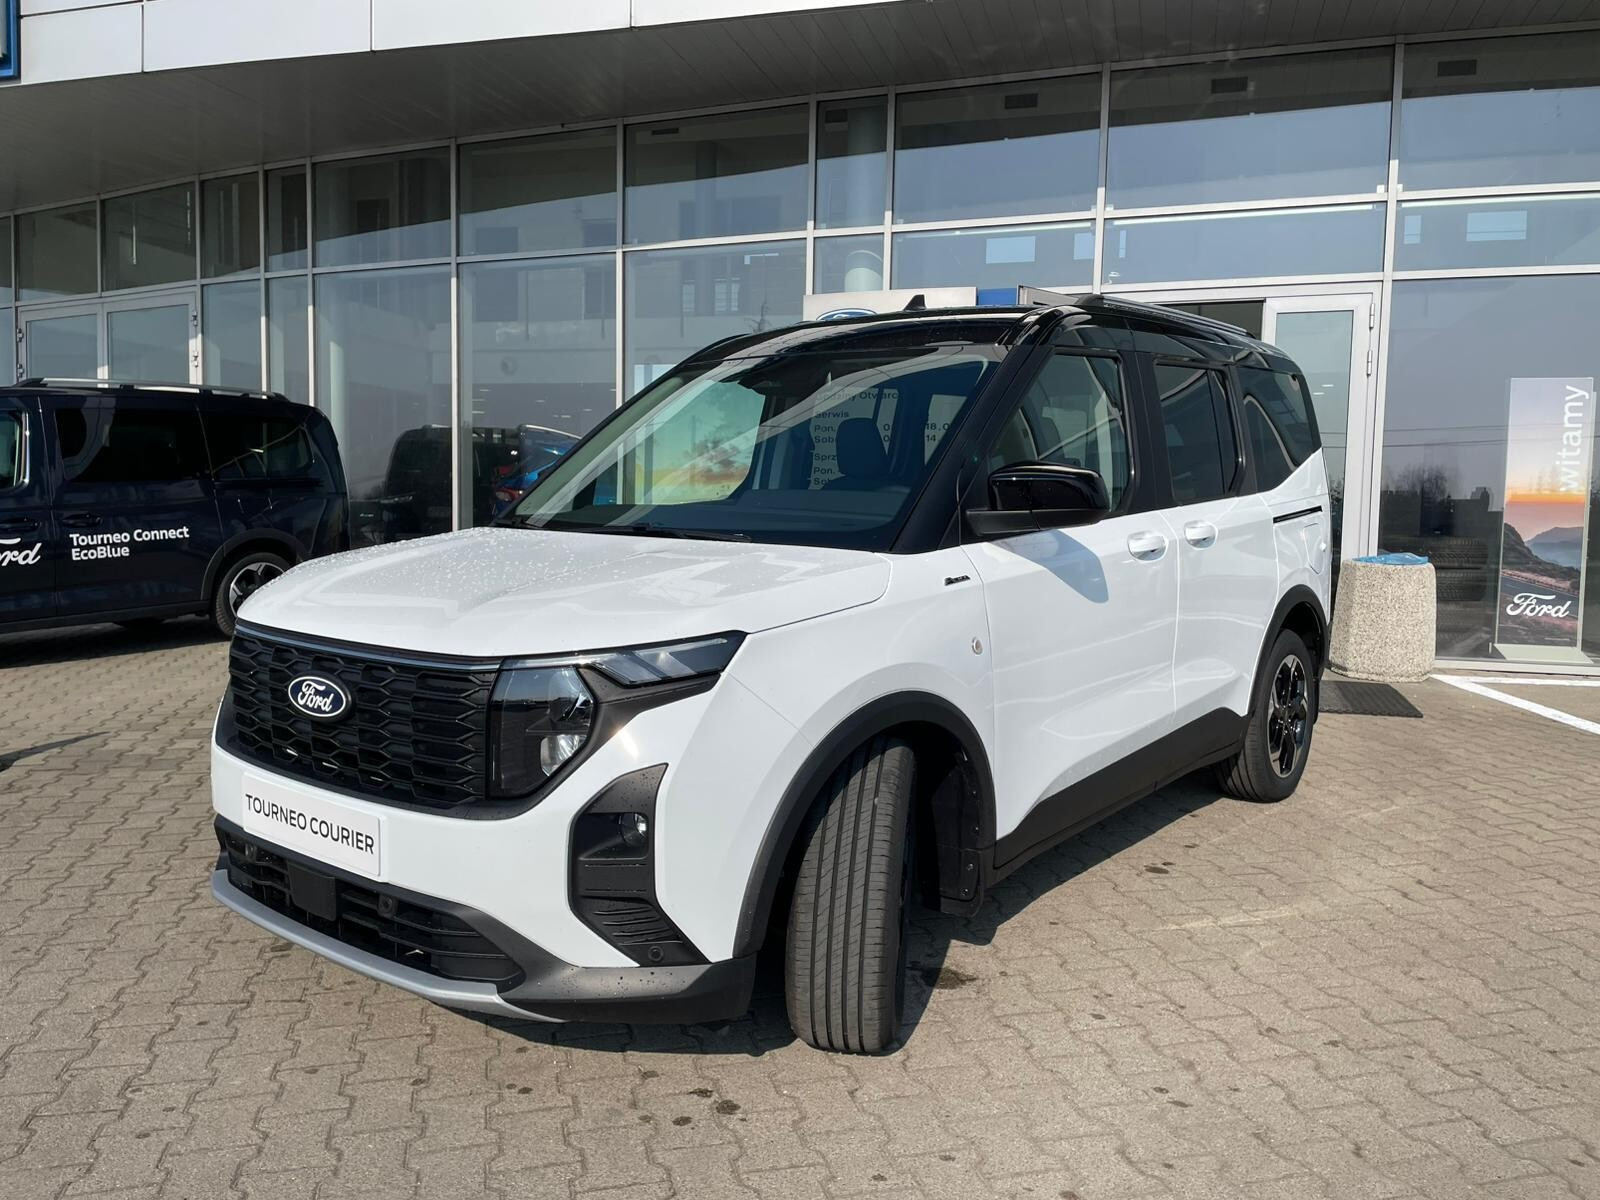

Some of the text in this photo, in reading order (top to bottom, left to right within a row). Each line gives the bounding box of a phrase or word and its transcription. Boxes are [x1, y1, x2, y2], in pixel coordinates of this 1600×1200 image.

[1555, 384, 1589, 492] witamy
[69, 526, 190, 546] Tourneo Connect
[0, 537, 42, 567] rd
[71, 545, 130, 560] EcoBlue
[1506, 592, 1571, 618] Ford
[297, 680, 335, 712] Ford
[245, 793, 374, 854] TOURNEO COURIER
